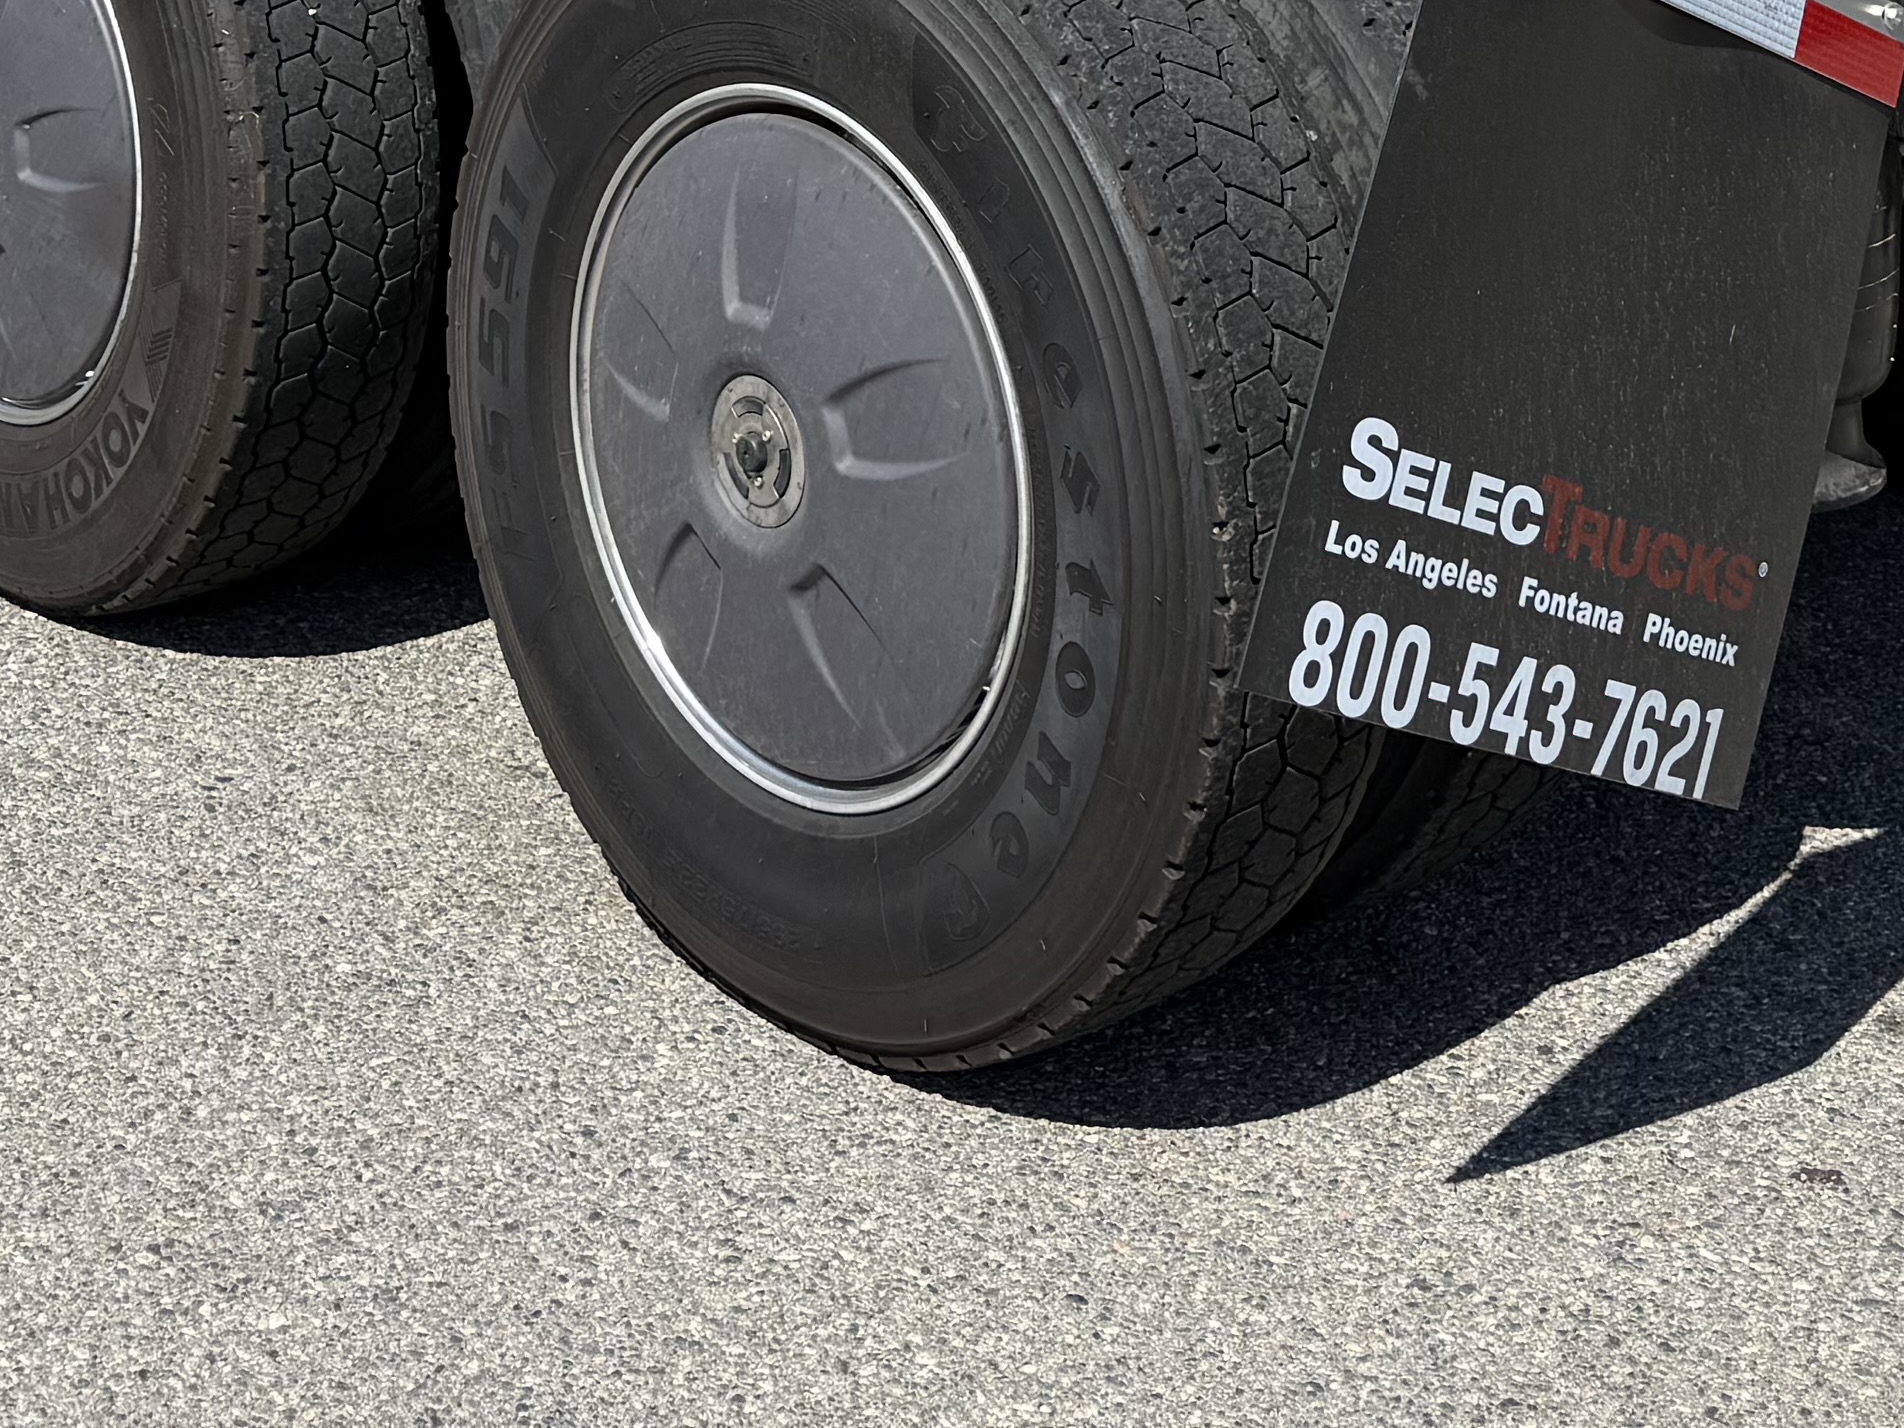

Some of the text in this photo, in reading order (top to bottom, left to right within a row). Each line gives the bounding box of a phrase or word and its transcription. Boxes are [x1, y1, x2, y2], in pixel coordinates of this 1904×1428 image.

[921, 82, 1117, 880] Firestone
[1324, 519, 1738, 667] Los Angeles Fontana Phoenix
[1289, 599, 1724, 800] 800-543-7621
